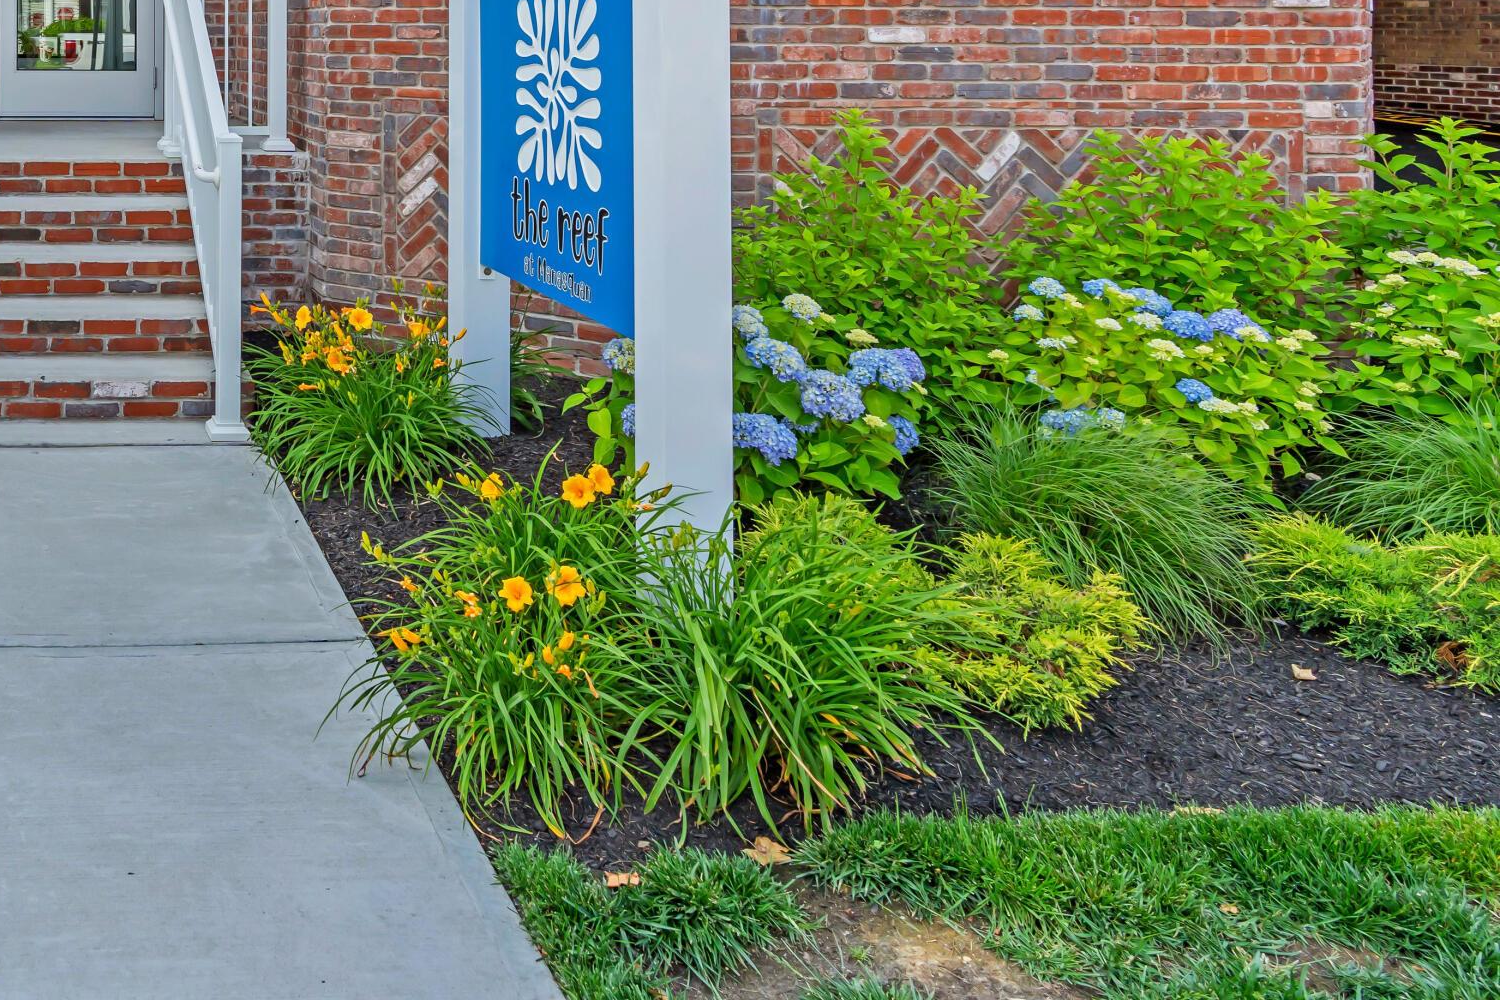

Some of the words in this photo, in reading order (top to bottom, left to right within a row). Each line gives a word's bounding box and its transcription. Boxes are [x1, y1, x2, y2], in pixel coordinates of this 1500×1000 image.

[511, 175, 549, 248] the
[557, 206, 610, 276] reef
[523, 252, 535, 277] at
[537, 255, 592, 304] Manasquan
